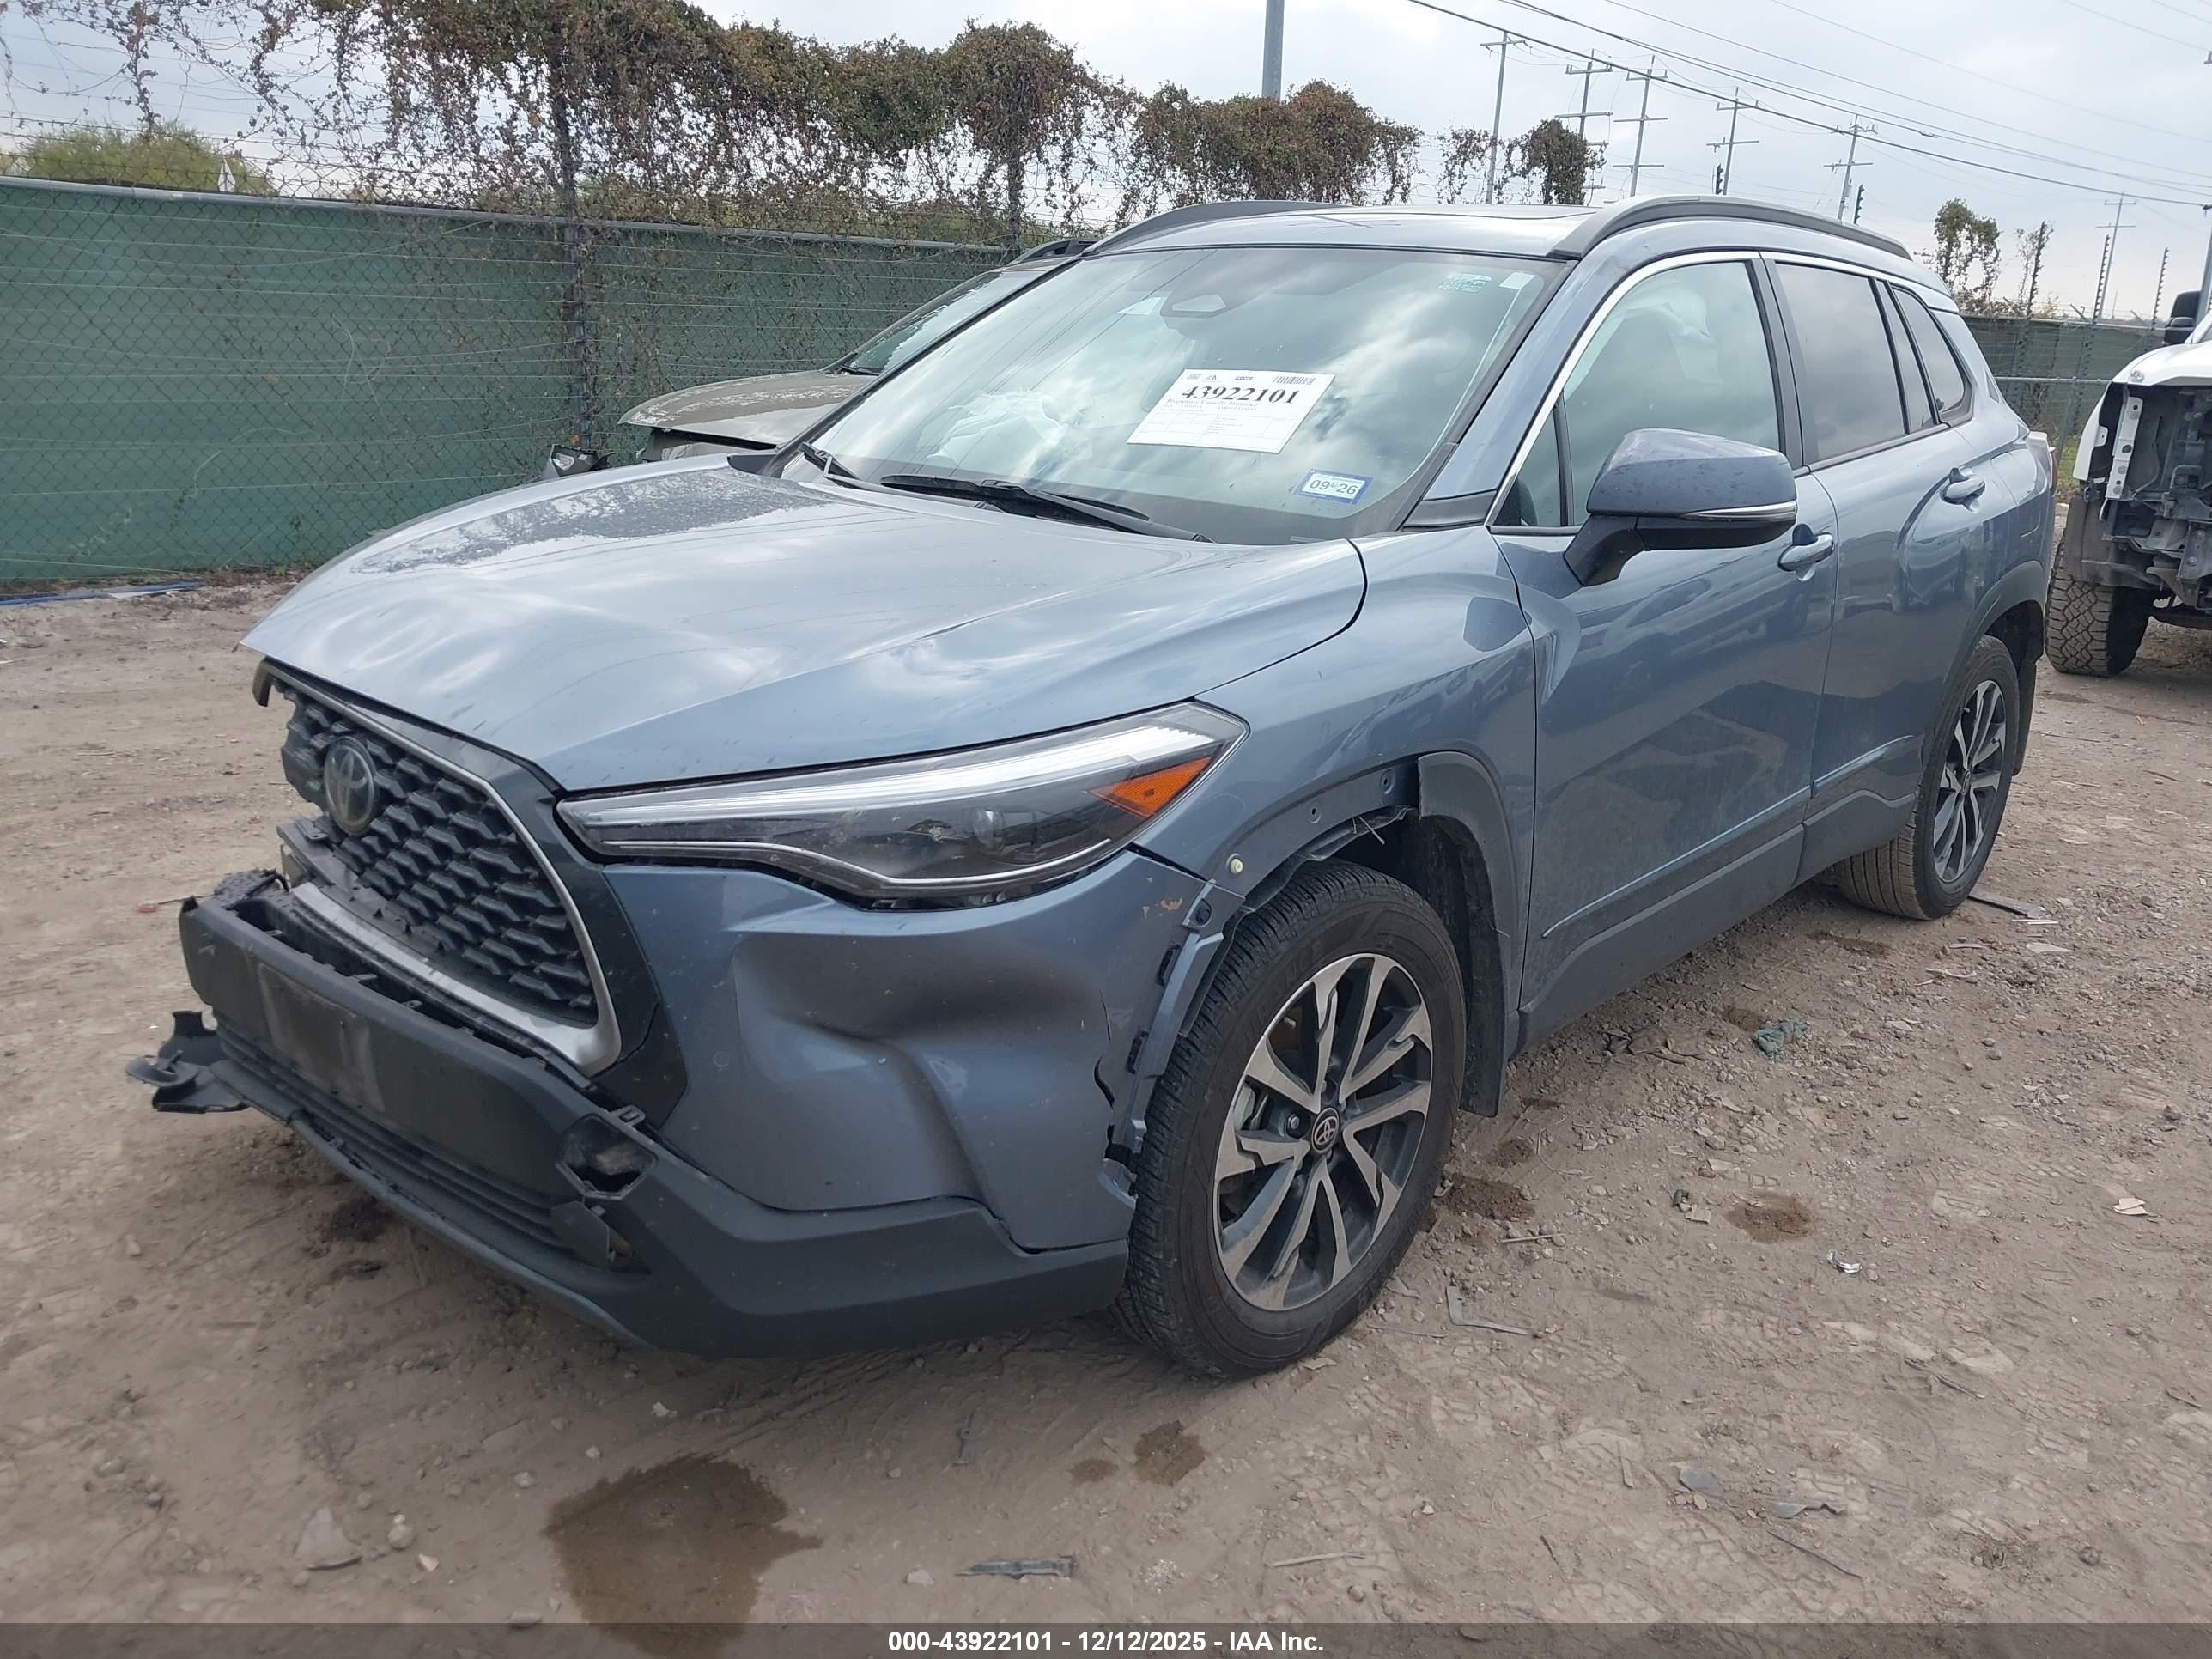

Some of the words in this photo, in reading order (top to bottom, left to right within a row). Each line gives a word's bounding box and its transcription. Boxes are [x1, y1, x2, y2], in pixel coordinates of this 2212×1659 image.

[1182, 385, 1300, 404] 43922101
[1310, 479, 1331, 490] 09
[1336, 483, 1358, 495] 26
